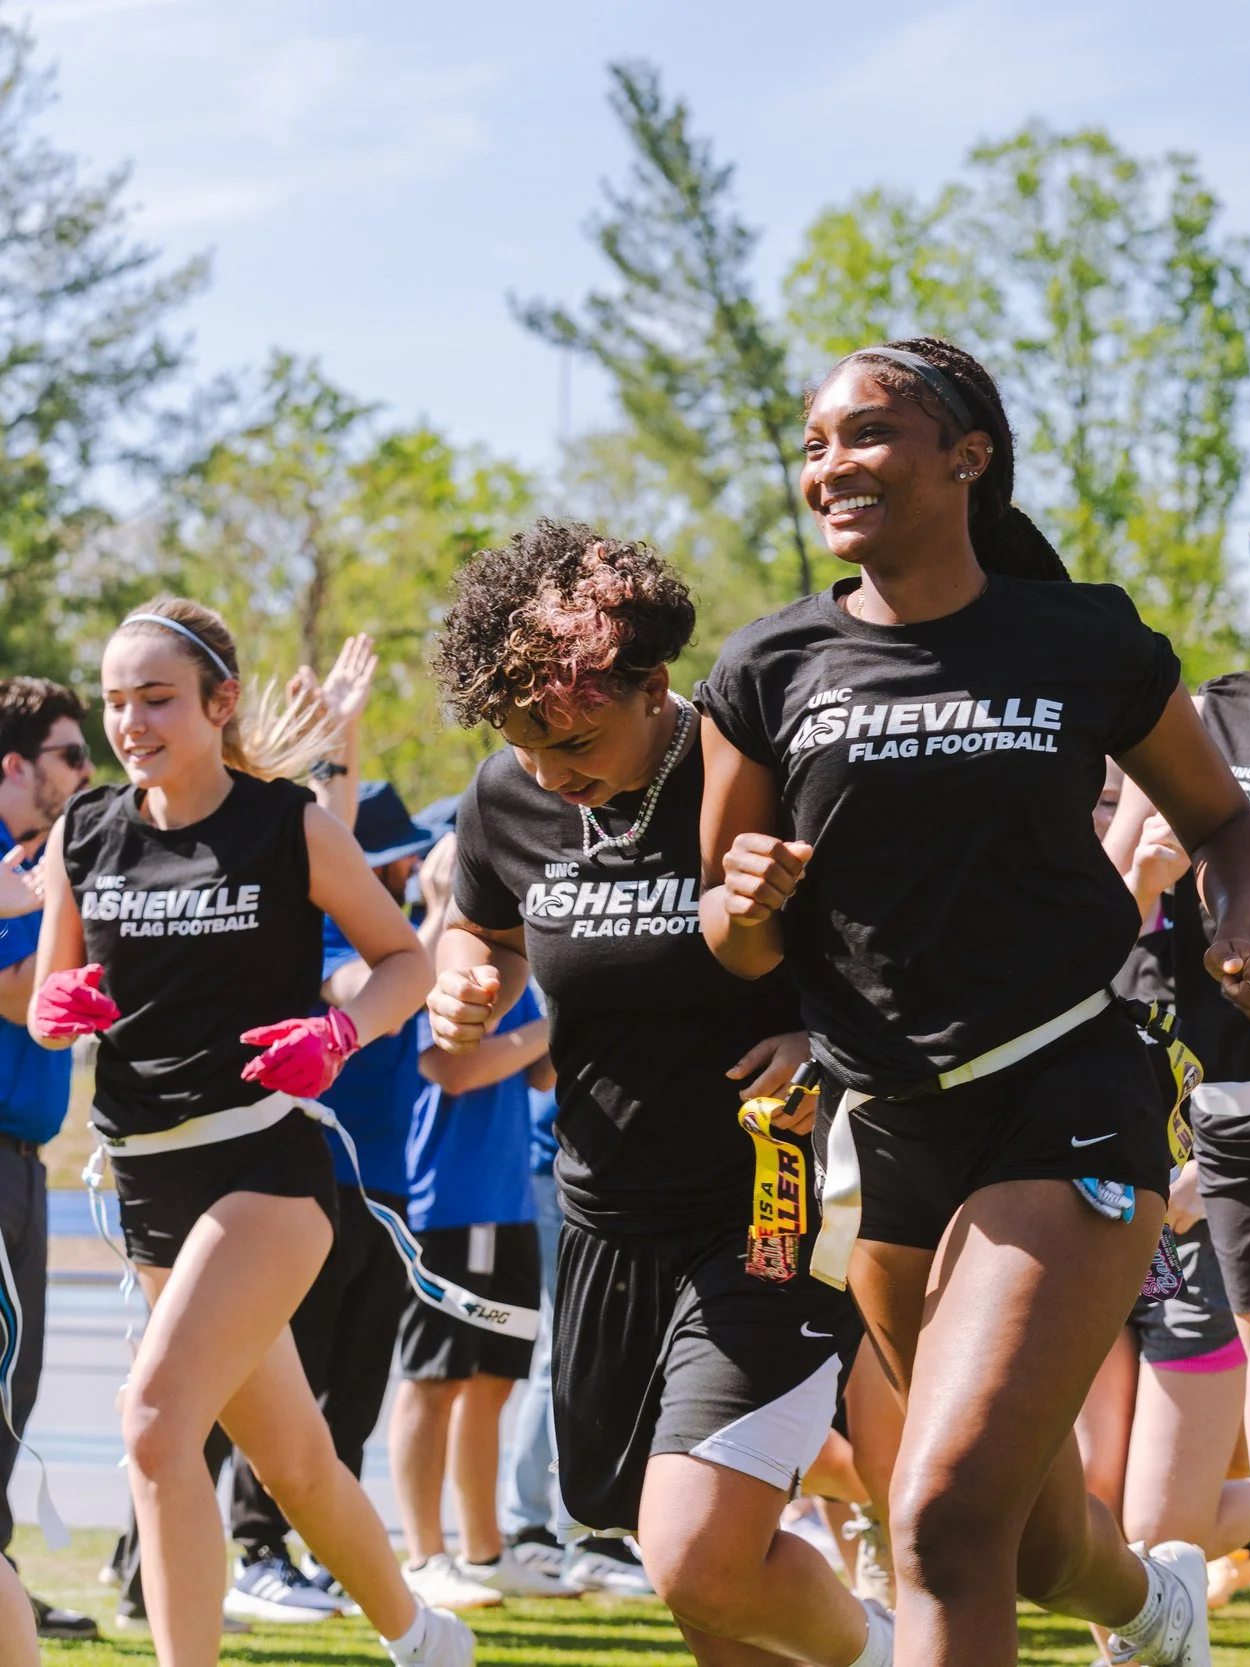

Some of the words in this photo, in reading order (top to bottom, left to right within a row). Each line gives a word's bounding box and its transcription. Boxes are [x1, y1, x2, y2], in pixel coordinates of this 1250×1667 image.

[807, 687, 853, 709] UNC
[789, 698, 1064, 754] ASHEVILLE
[848, 738, 920, 763] FLAG
[924, 731, 1059, 756] FOOTBALL
[545, 862, 580, 878] UNC
[95, 875, 127, 890] UNC
[81, 885, 261, 921] ASHEVILLE
[120, 921, 165, 937] FLAG
[167, 913, 259, 936] FOOTBALL
[571, 918, 631, 938] FLAG
[634, 916, 703, 937] FOOT
[760, 1182, 774, 1198] A
[760, 1200, 774, 1222] IS
